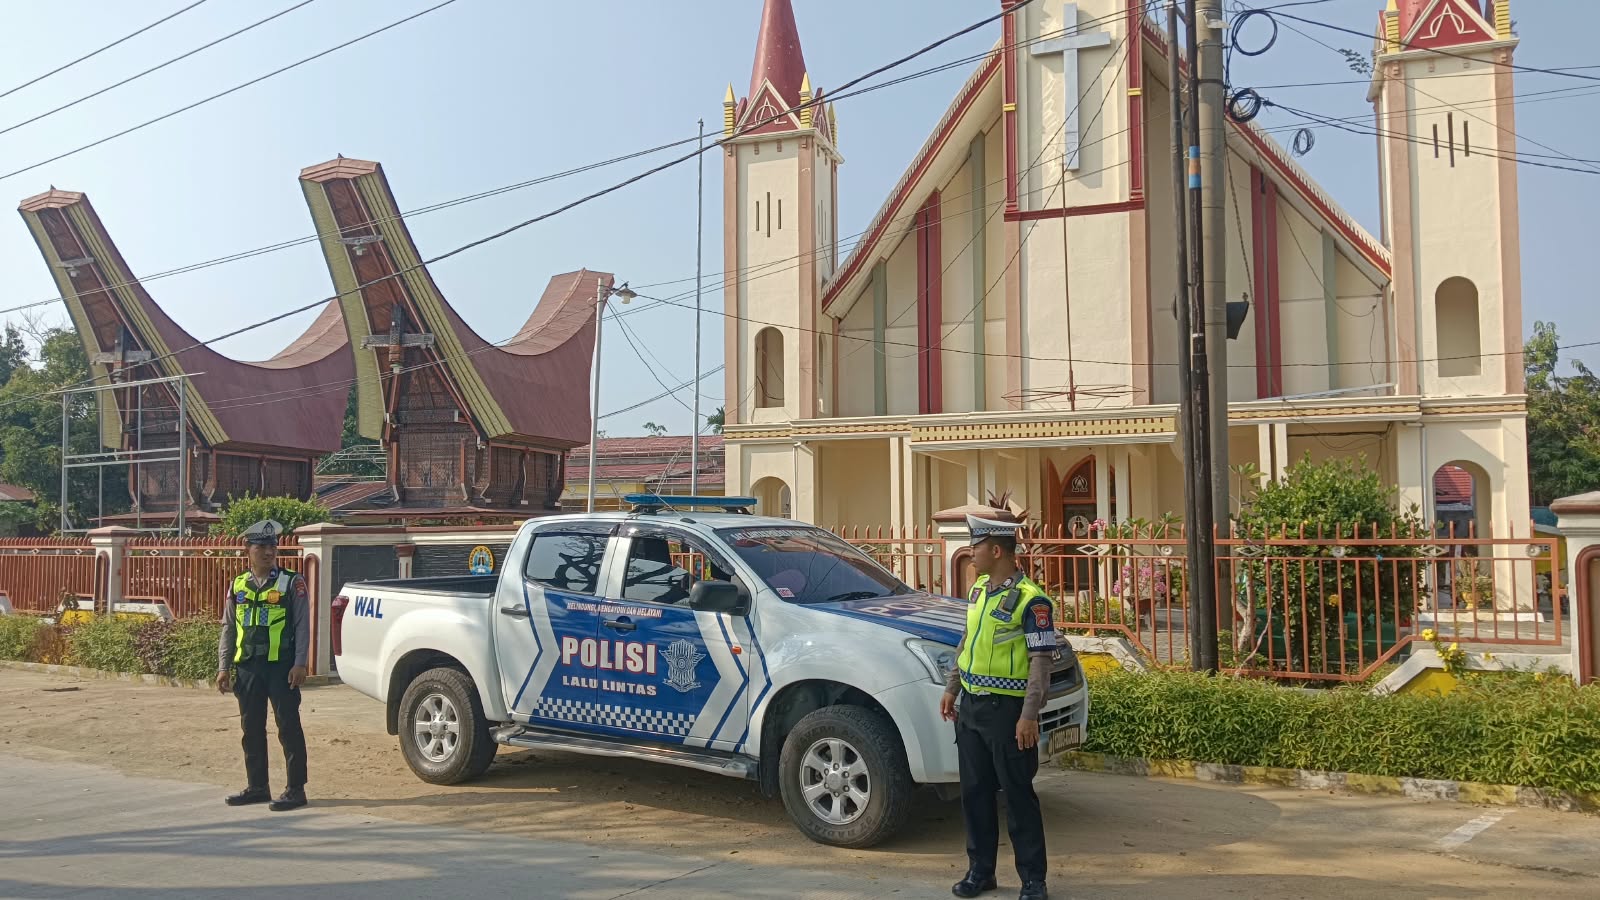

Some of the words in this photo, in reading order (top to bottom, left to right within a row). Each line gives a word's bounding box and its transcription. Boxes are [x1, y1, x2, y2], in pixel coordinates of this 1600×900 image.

[354, 595, 383, 619] WAL
[562, 636, 657, 676] POLISI
[562, 675, 598, 689] LALU
[602, 680, 657, 696] LINTAS
